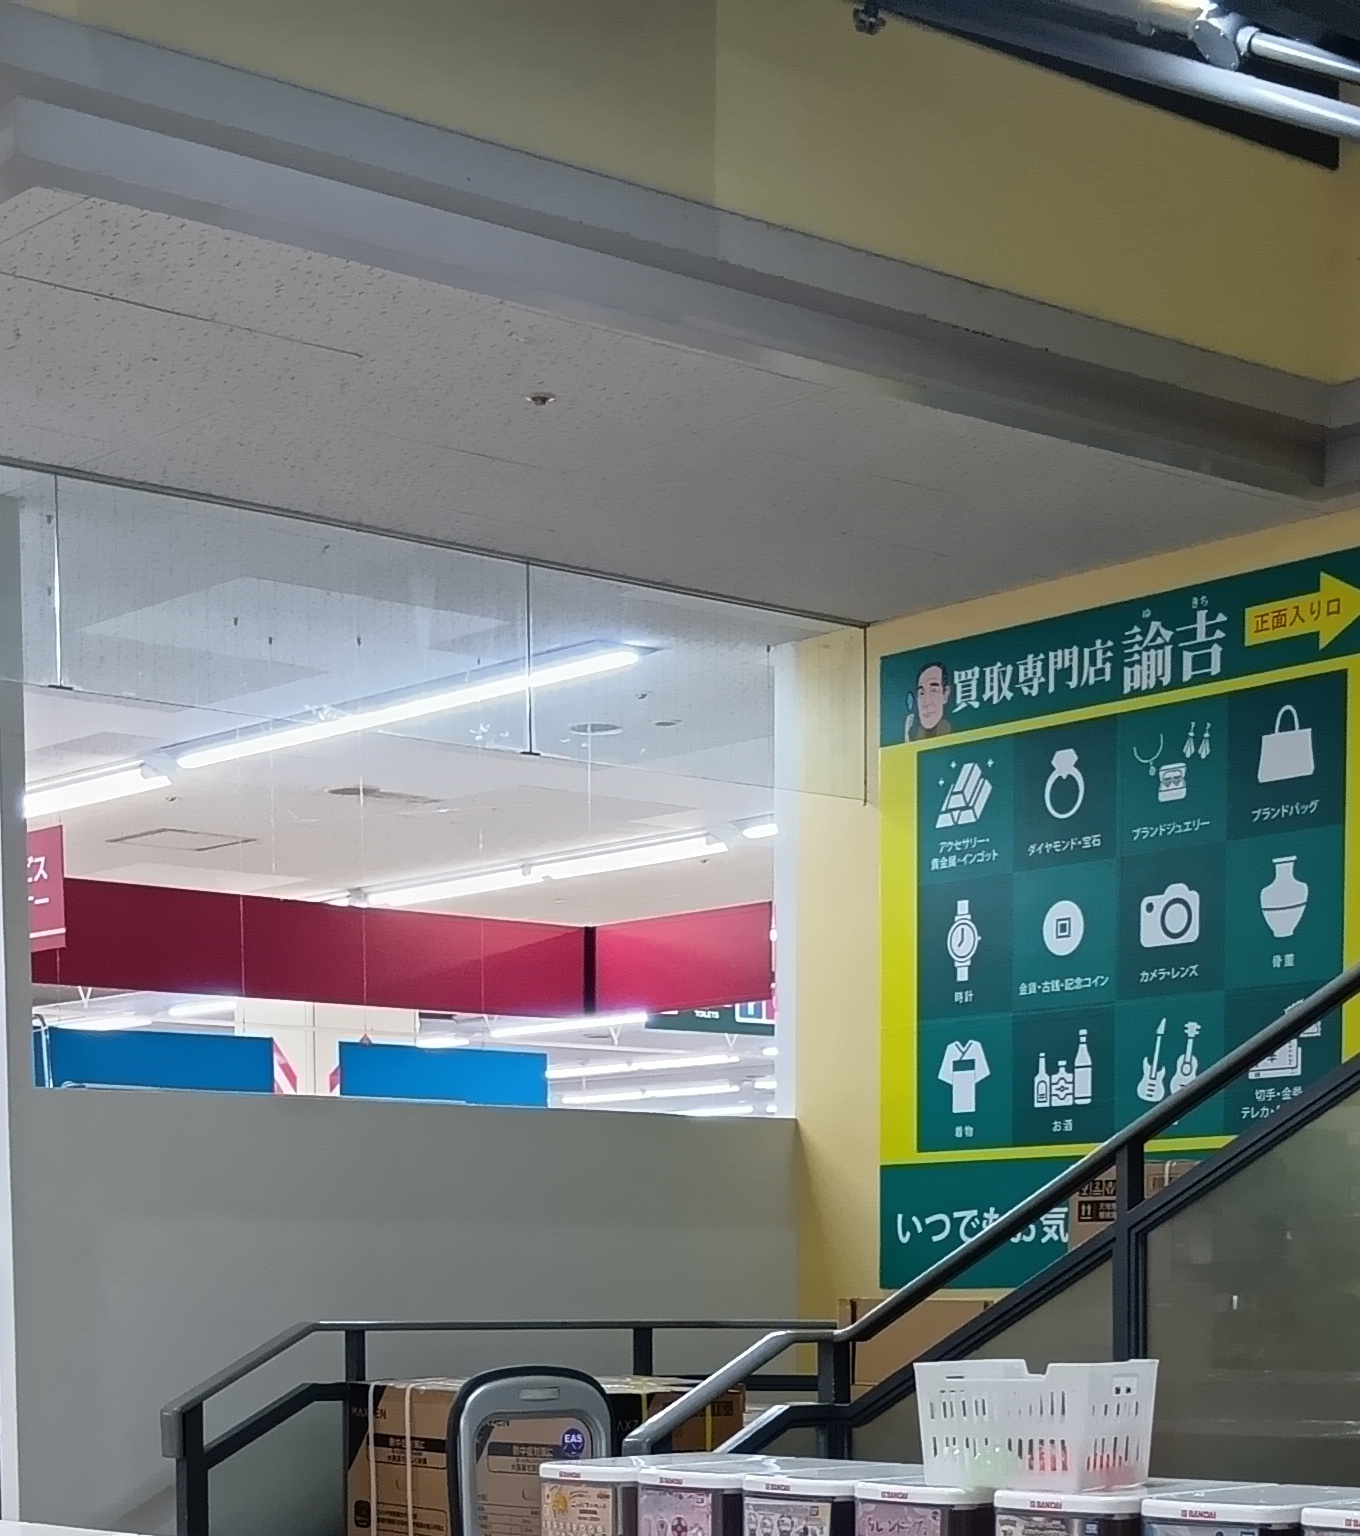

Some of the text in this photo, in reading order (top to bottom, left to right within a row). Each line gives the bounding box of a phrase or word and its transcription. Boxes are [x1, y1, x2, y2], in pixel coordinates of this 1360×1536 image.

[1253, 597, 1342, 635] 正面入り口
[952, 608, 1229, 714] 買取専門店 諭吉
[1251, 799, 1320, 822] ブランドバッグ
[1131, 818, 1210, 842] ブランドジュエリー
[1027, 833, 1102, 857] ダイヤモンド・宝石
[930, 848, 999, 872] 貴金属・インゴット
[1272, 953, 1296, 969] 骨董
[1140, 963, 1200, 984] カメラ・レンズ
[1018, 974, 1110, 996] 金貨・古銭・記念コイン
[954, 989, 974, 1004] 時計
[1240, 1104, 1281, 1120] テレカ・
[954, 1124, 975, 1139] 着物
[1051, 1118, 1073, 1133] お酒
[352, 1406, 387, 1420] MAXEN
[564, 1434, 583, 1443] EAS
[1036, 1500, 1063, 1510] BANDAI
[1188, 1510, 1217, 1519] BANDAI
